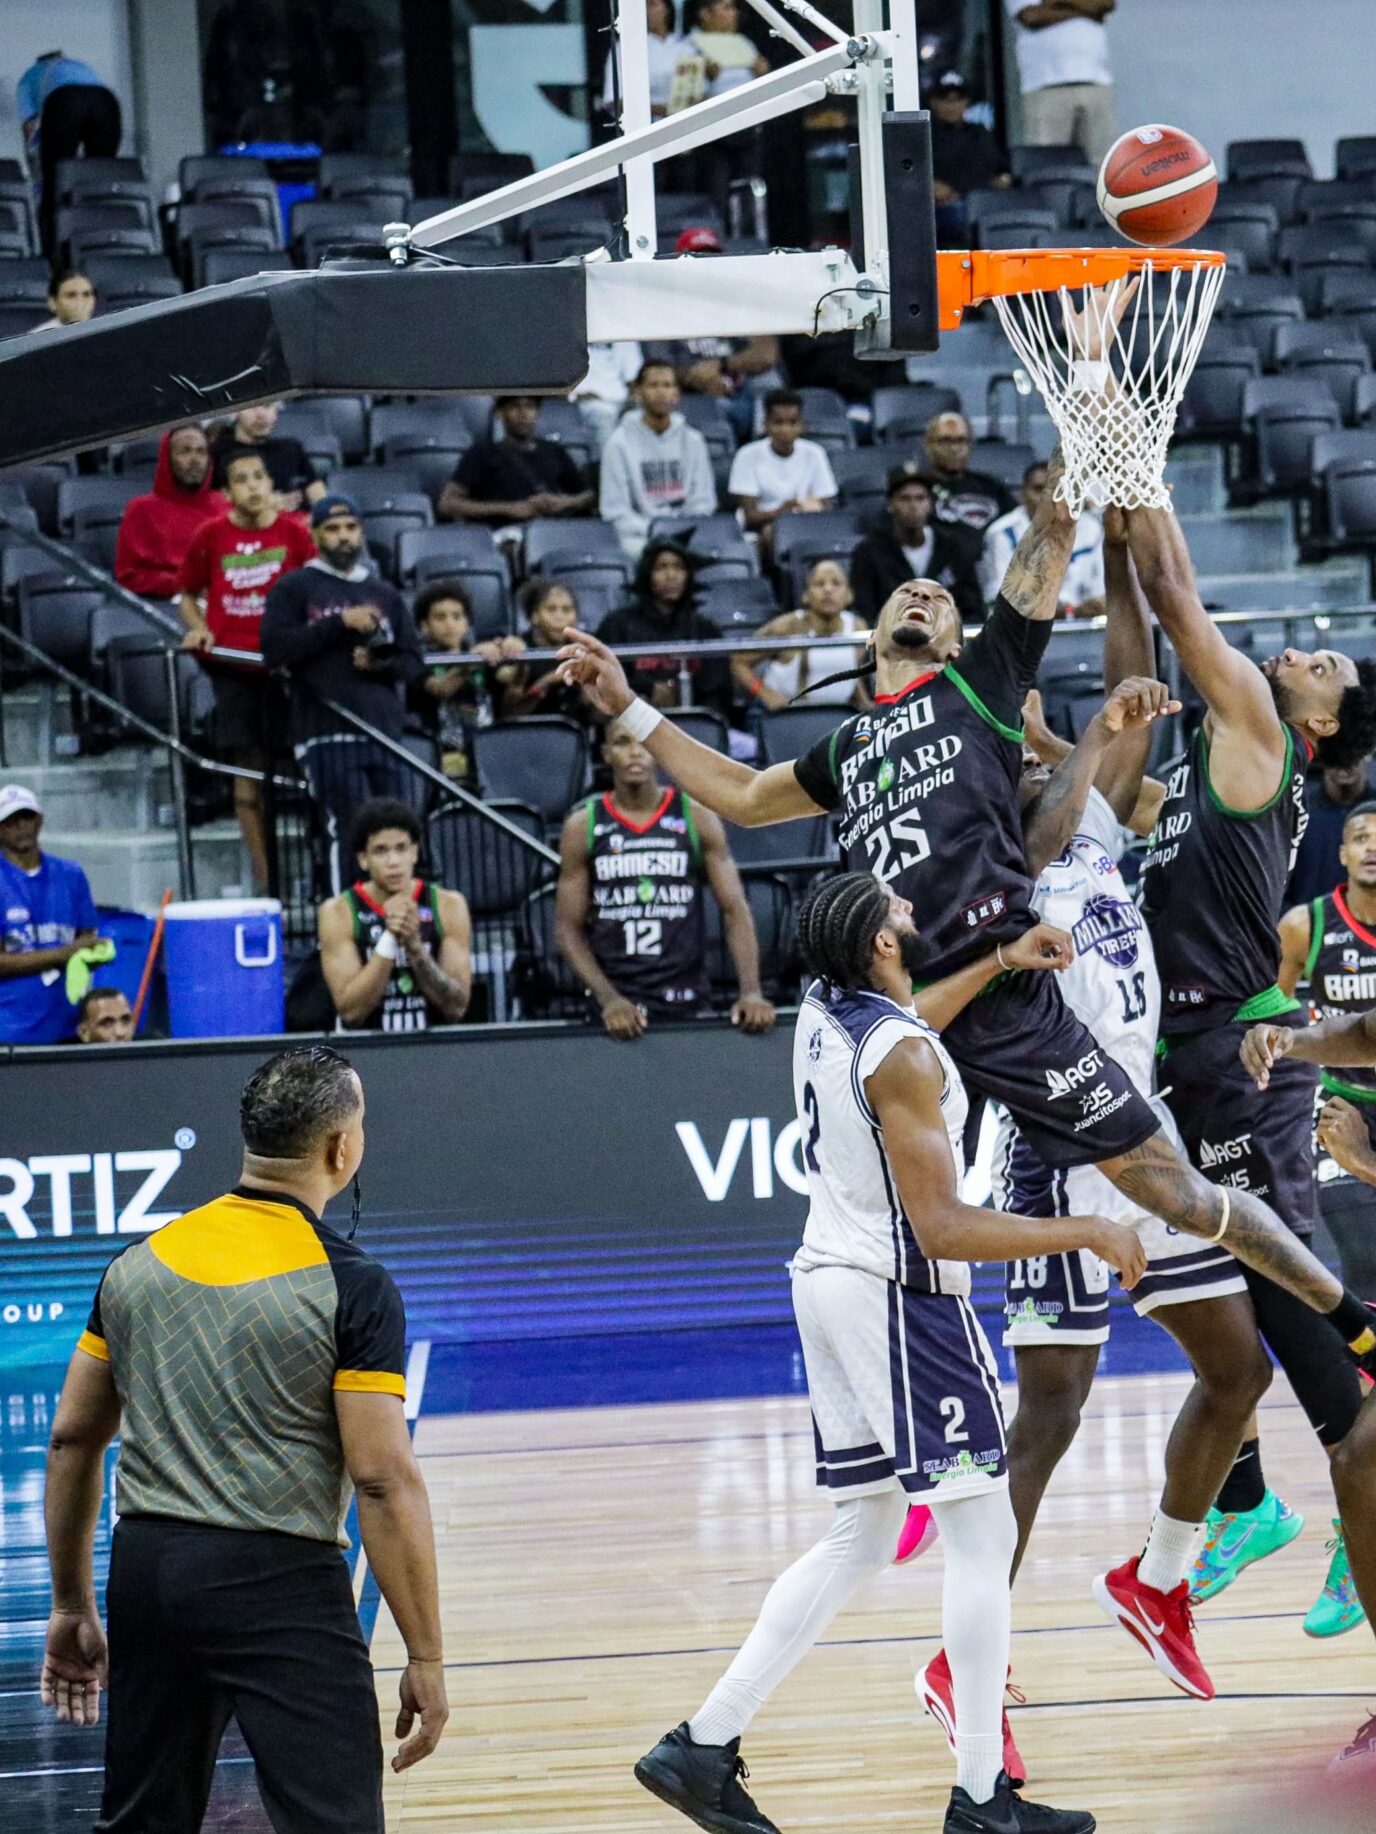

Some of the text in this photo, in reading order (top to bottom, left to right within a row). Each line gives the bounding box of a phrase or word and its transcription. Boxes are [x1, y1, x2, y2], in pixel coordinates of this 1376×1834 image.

[887, 767, 955, 812] Limpia
[865, 806, 931, 883] 25
[595, 851, 689, 881] BAMESO
[623, 919, 663, 956] 12
[1064, 1049, 1104, 1089] AGT
[1213, 1133, 1252, 1165] AGT
[1010, 1255, 1049, 1290] 18
[939, 1396, 970, 1444] 2
